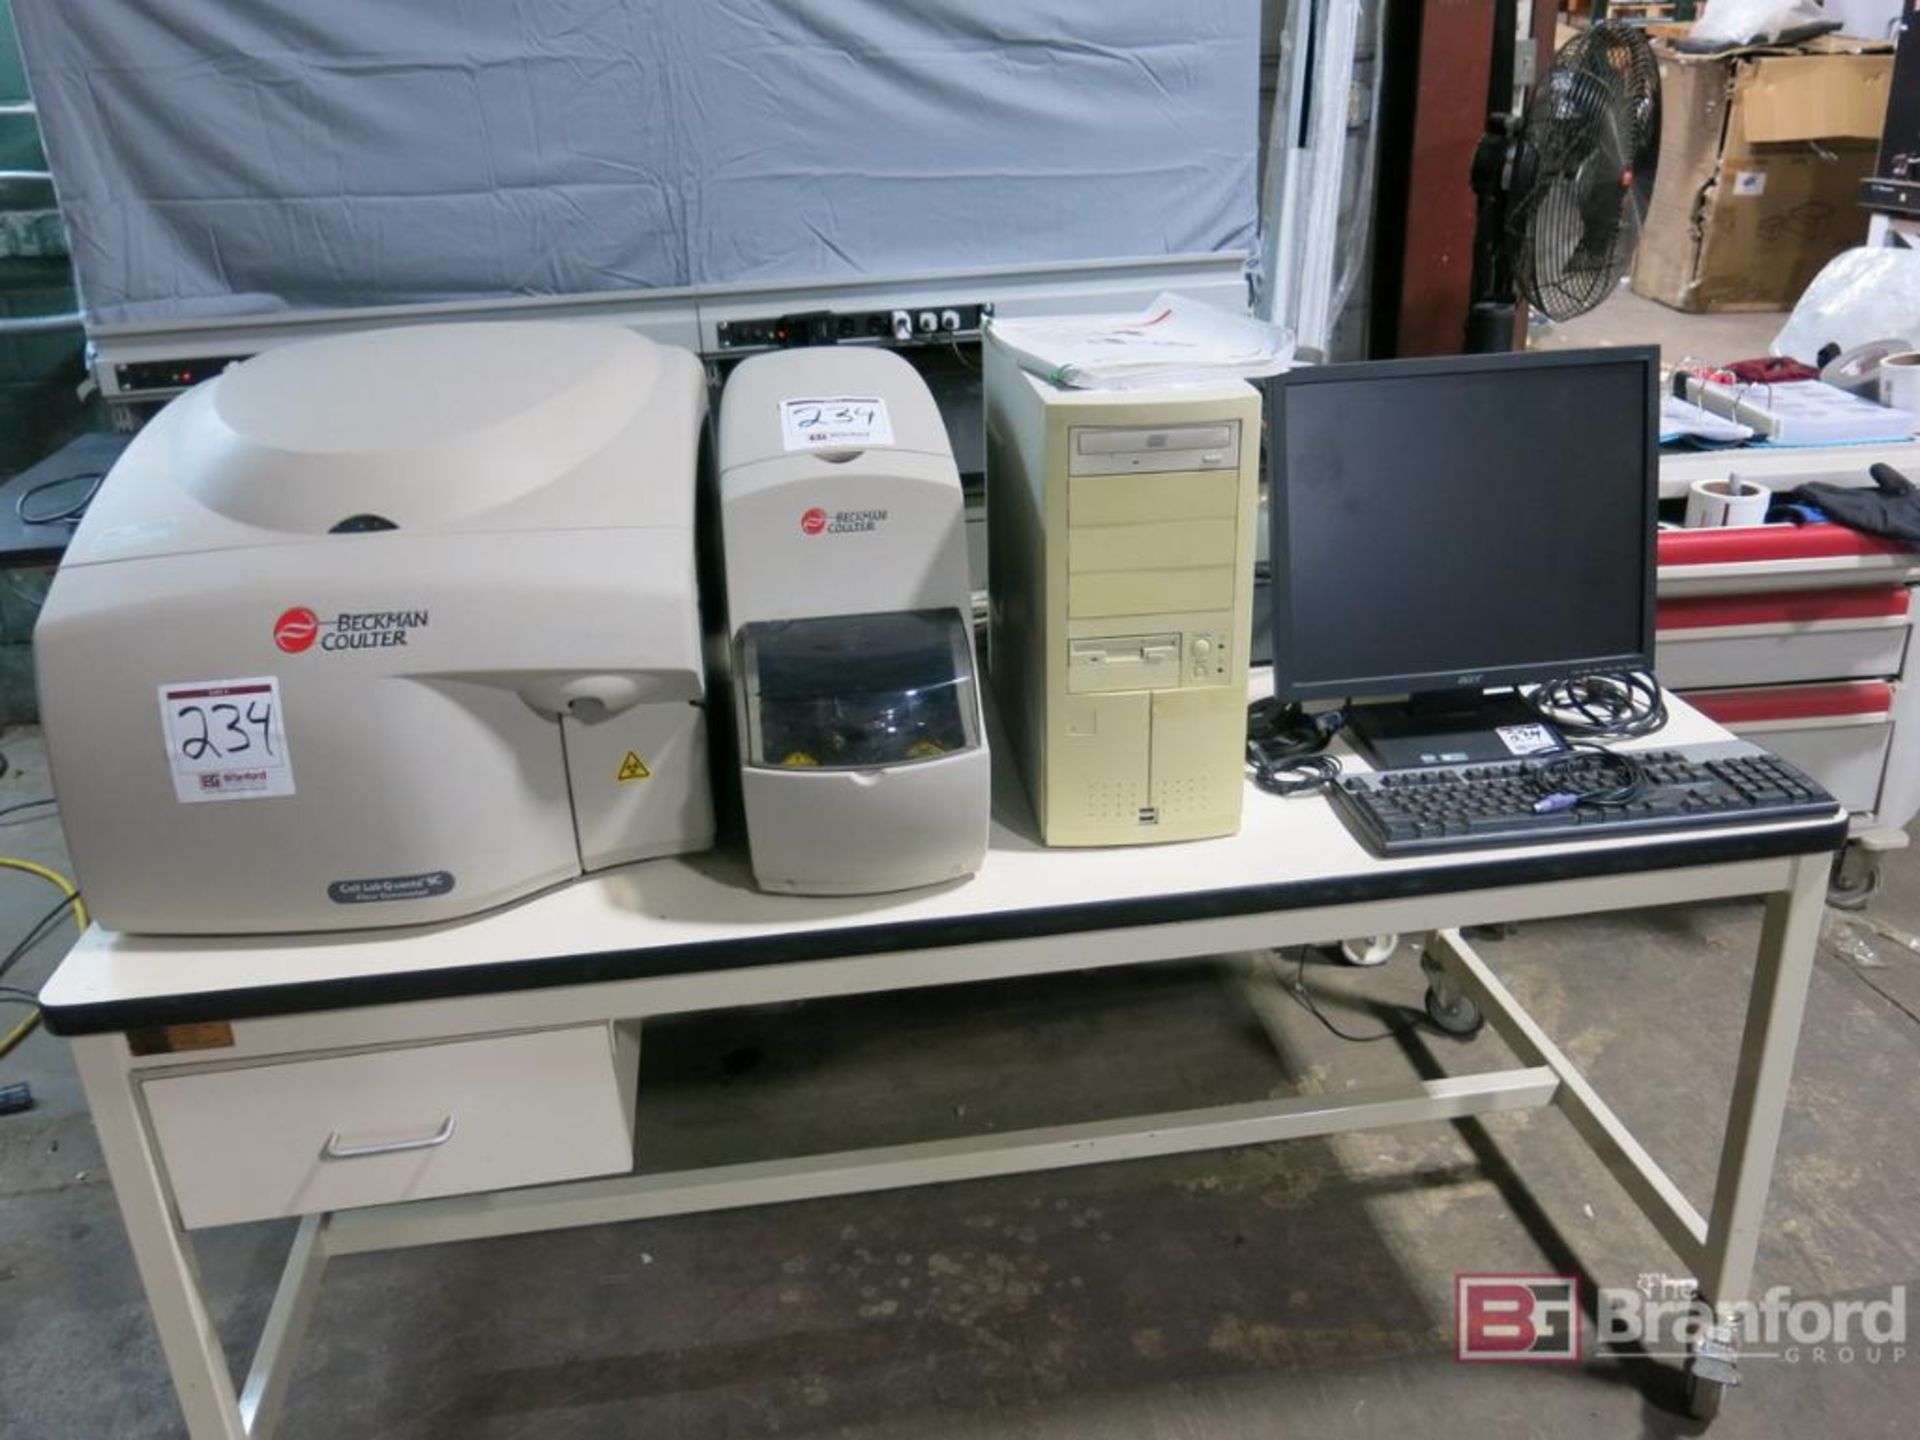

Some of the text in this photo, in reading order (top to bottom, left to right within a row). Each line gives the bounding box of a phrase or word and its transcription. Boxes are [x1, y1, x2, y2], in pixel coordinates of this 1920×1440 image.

[793, 406, 875, 428] 234
[836, 510, 888, 522] BECKMAN
[827, 521, 876, 533] COULTER
[338, 611, 429, 632] BECKMAN
[321, 630, 407, 651] COULTER
[178, 700, 274, 760] 234
